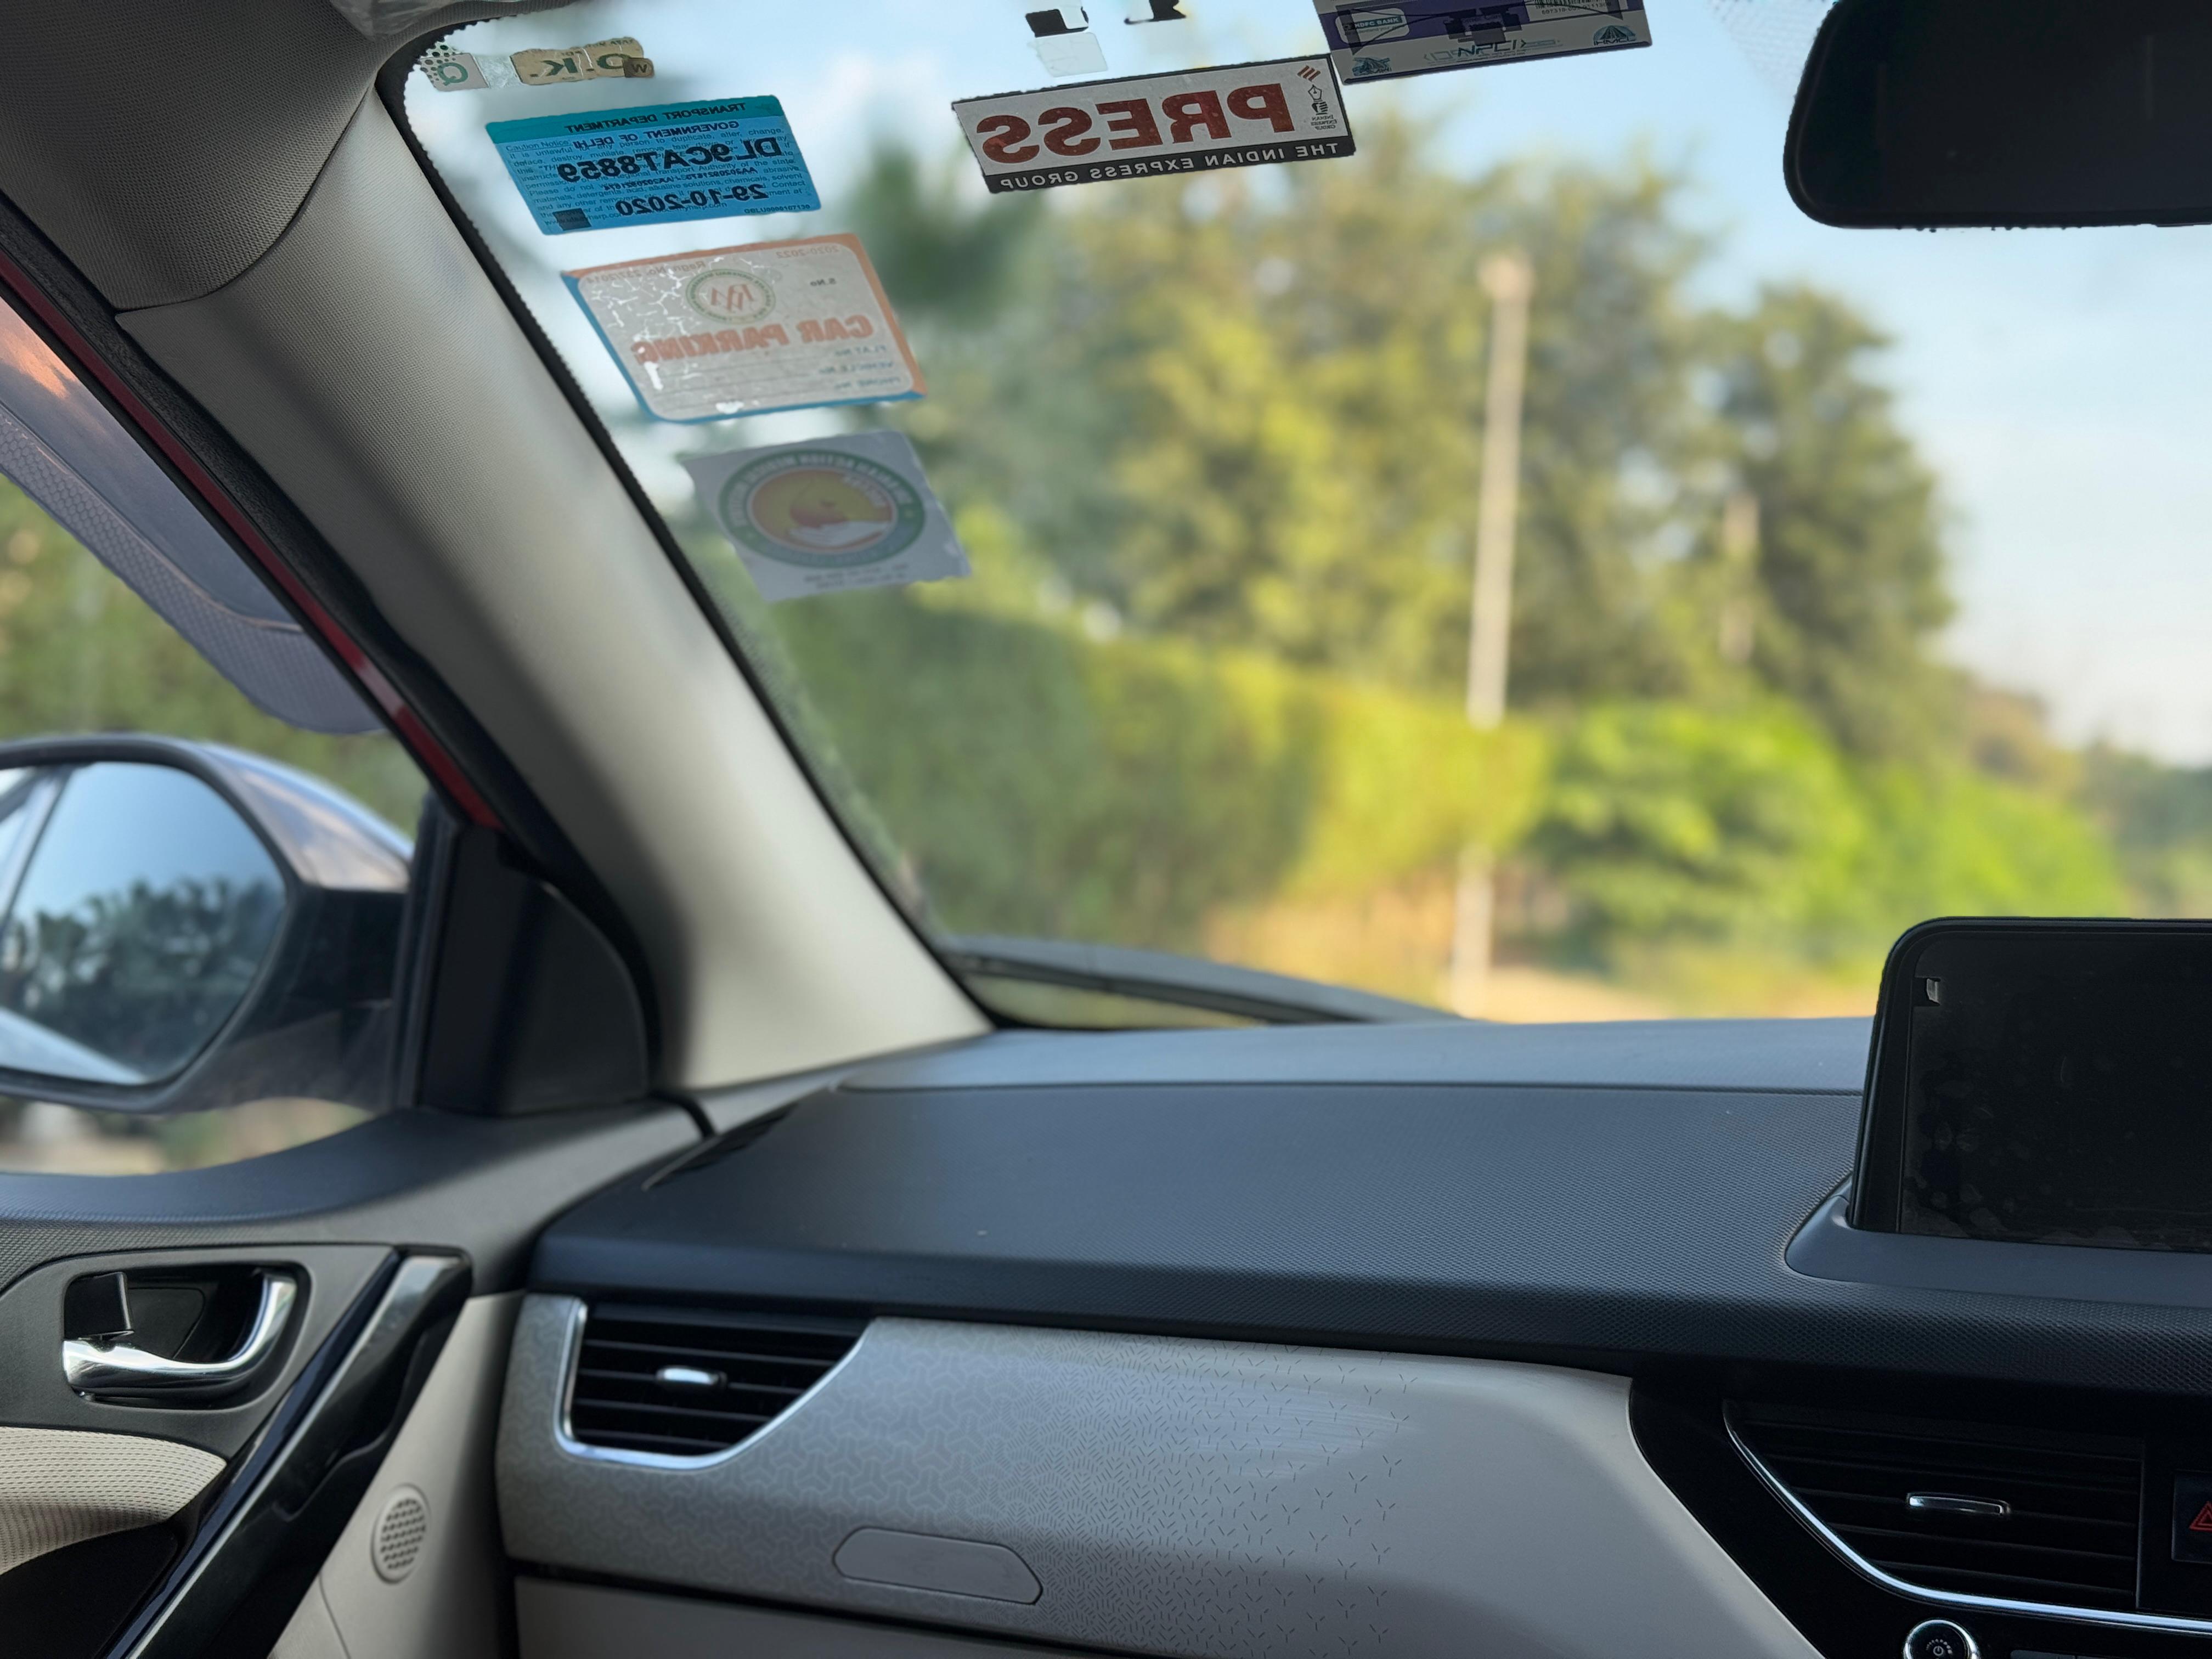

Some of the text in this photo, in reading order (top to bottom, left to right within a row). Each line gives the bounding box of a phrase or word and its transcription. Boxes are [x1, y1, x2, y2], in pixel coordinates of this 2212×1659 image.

[505, 143, 539, 152] Caution
[535, 147, 573, 156] unlawful
[574, 199, 597, 207] other
